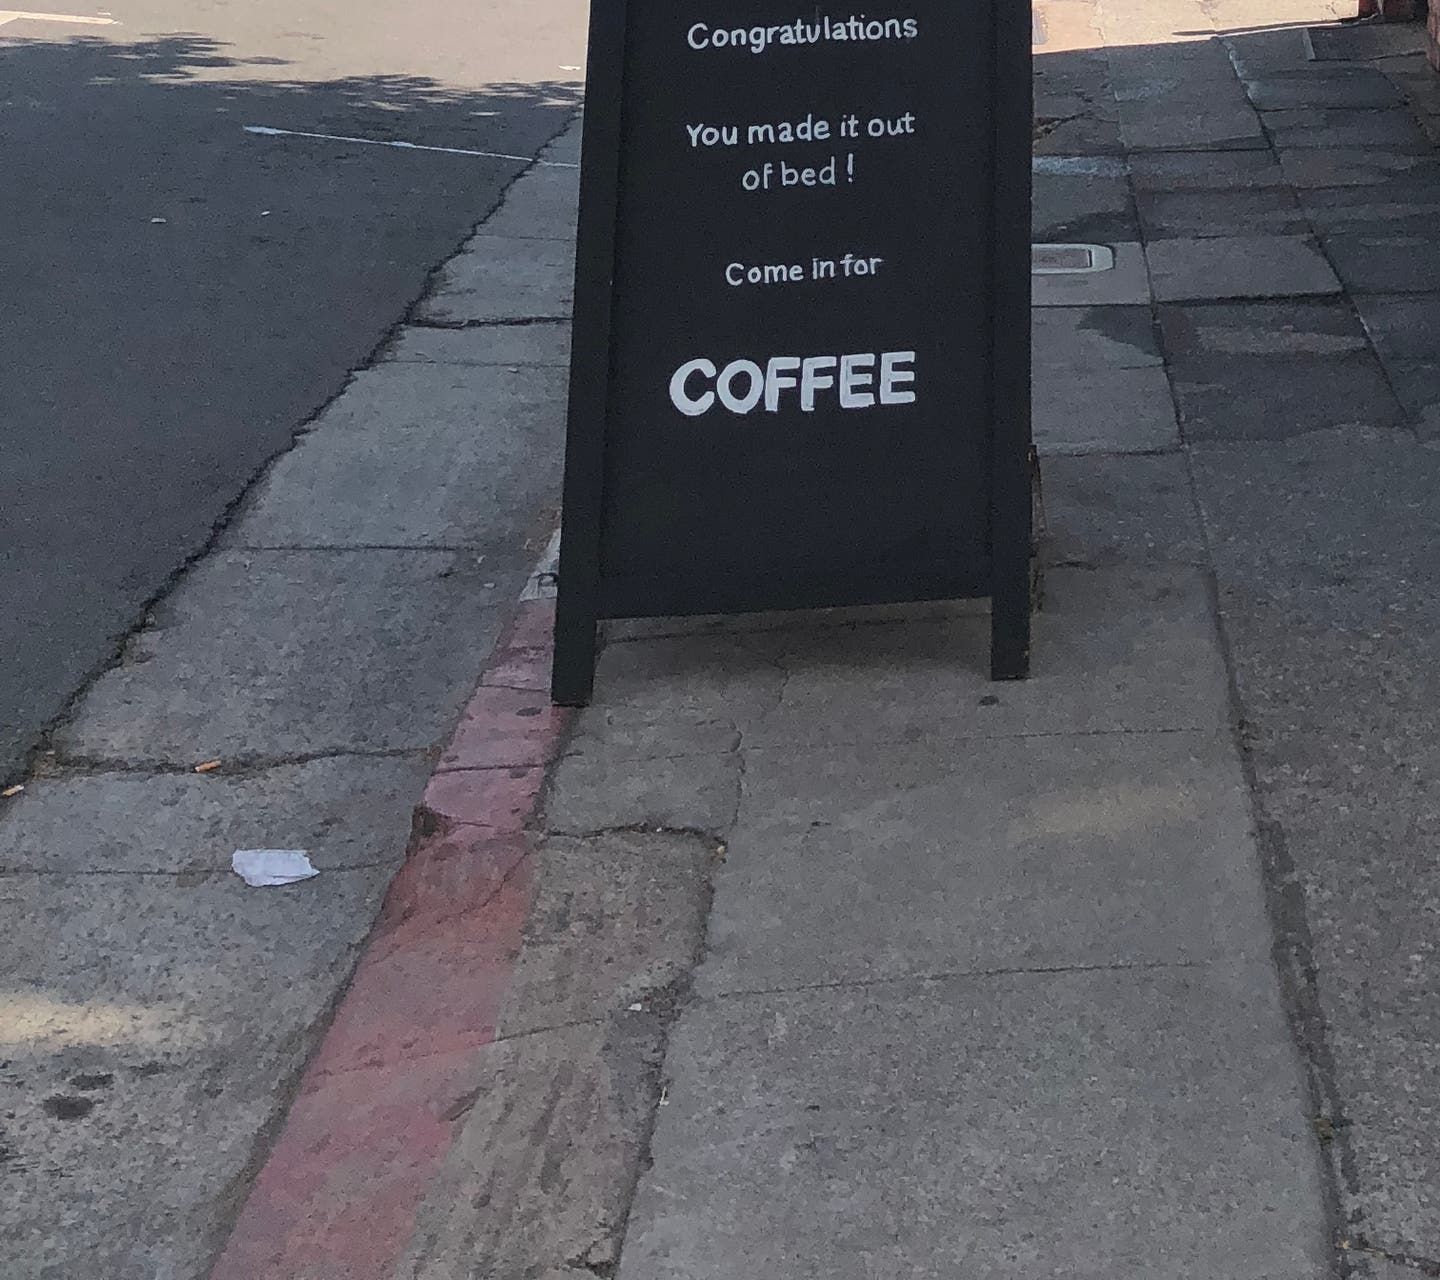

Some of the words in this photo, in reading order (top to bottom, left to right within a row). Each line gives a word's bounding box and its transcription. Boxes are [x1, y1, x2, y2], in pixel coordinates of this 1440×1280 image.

[686, 13, 918, 54] Congratulations
[685, 123, 739, 147] You
[747, 114, 831, 144] made
[839, 114, 859, 139] it
[867, 111, 916, 138] out
[741, 162, 771, 192] of
[724, 261, 804, 287] Come
[812, 258, 835, 281] in
[838, 253, 883, 278] for
[668, 350, 917, 417] COFFEE
